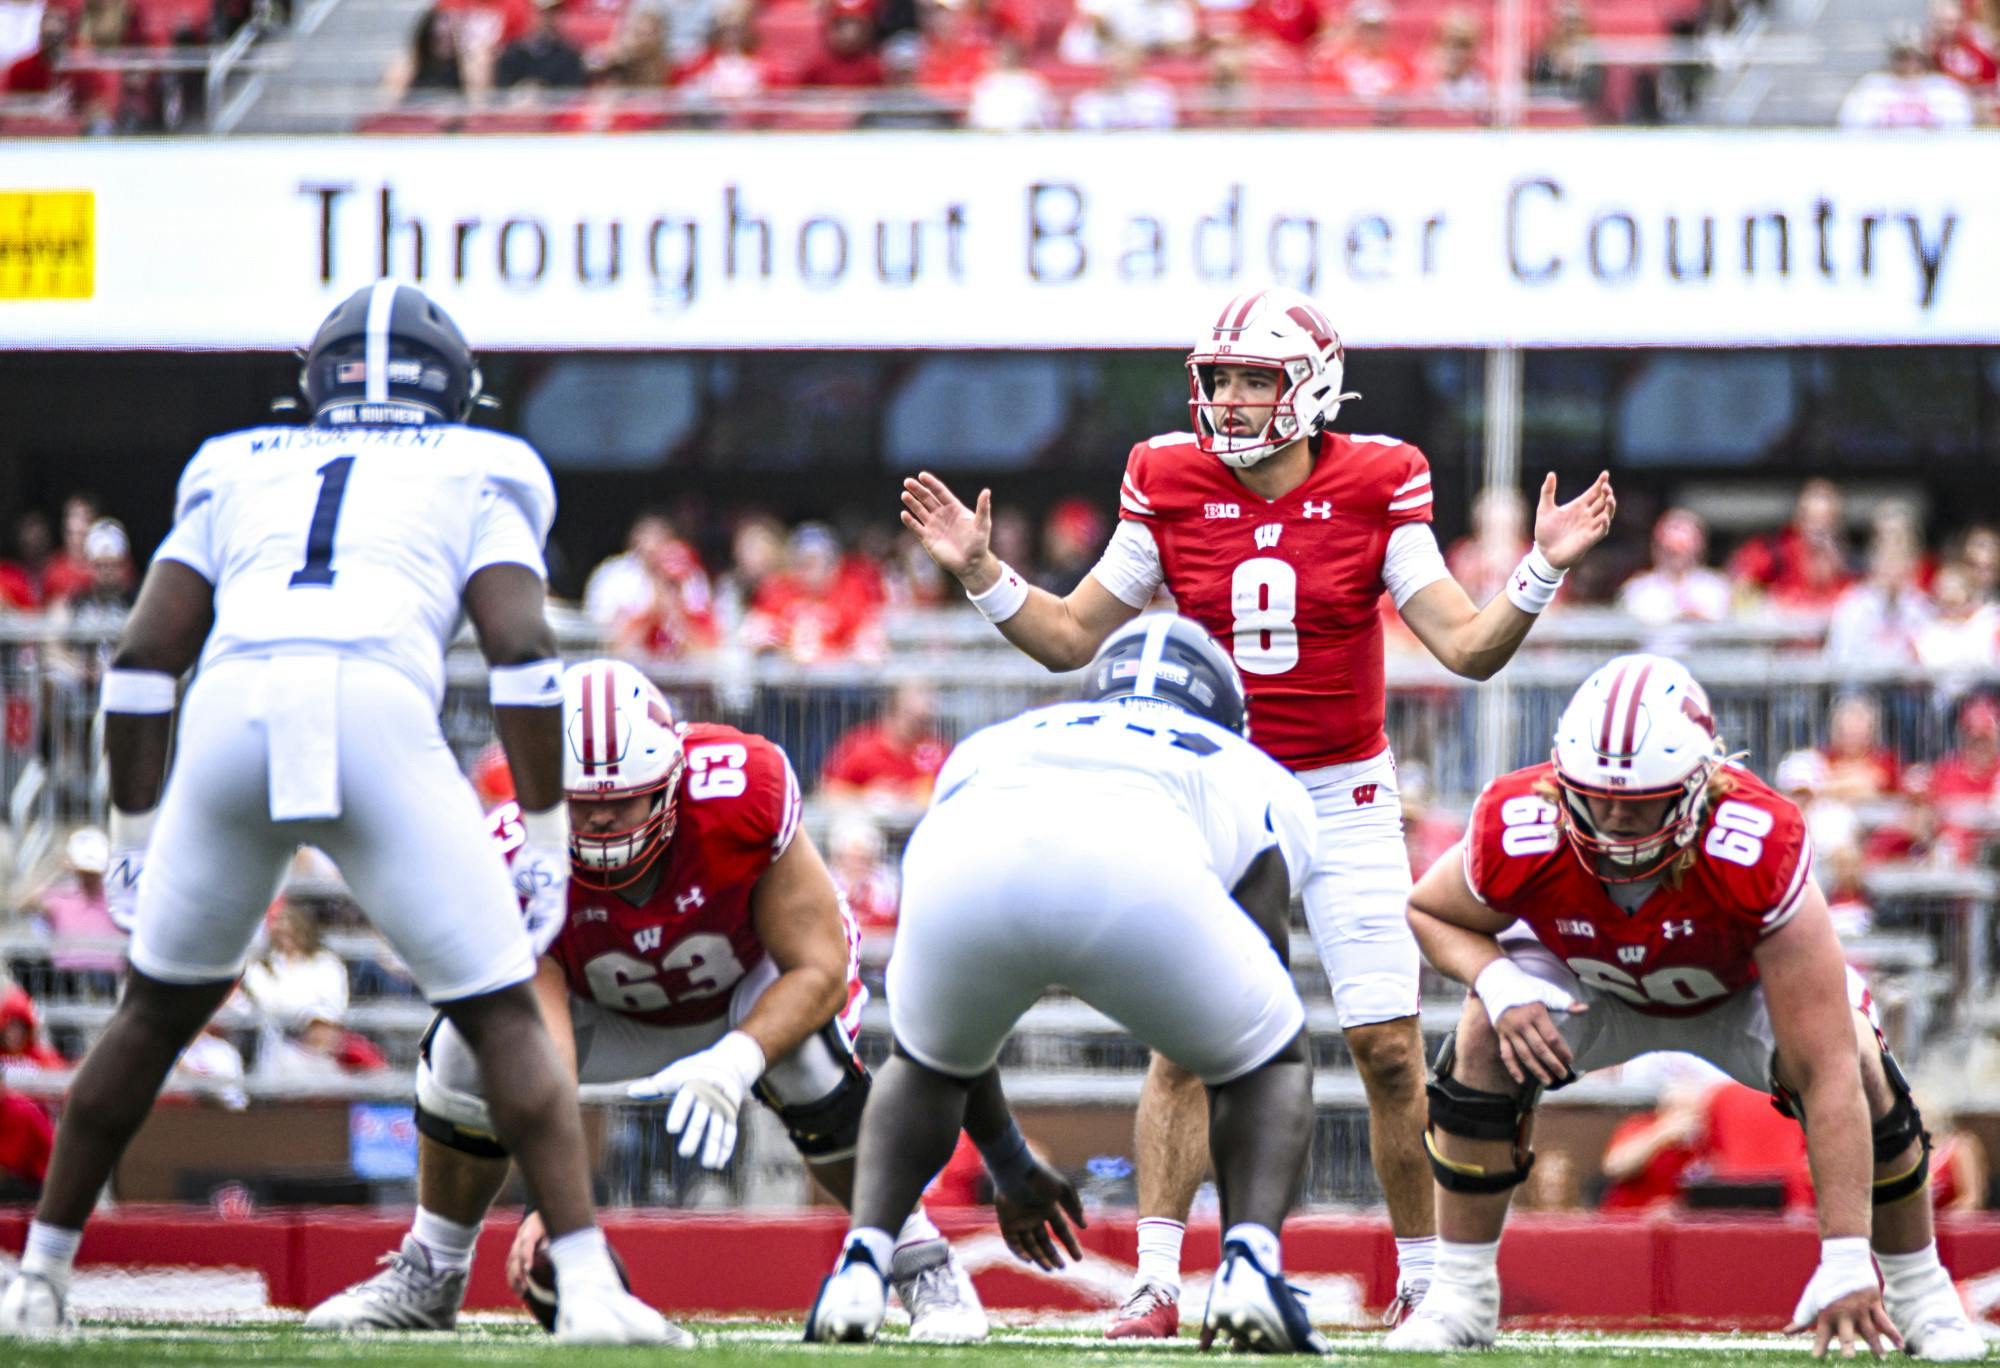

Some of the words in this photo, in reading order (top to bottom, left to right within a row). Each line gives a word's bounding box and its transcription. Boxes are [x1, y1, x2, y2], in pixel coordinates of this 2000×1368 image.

[298, 179, 969, 311] Throughout
[1028, 181, 1451, 292] Badger
[1505, 176, 1958, 310] Country
[287, 455, 357, 589] 1
[1254, 523, 1283, 550] W
[1231, 557, 1299, 675] 8
[688, 744, 747, 800] 63
[1352, 783, 1378, 807] W
[1501, 795, 1560, 857] 60
[1705, 800, 1774, 867] 60
[633, 926, 662, 953] W
[1617, 945, 1646, 963] W
[584, 932, 745, 1012] 63
[1566, 957, 1729, 1006] 60
